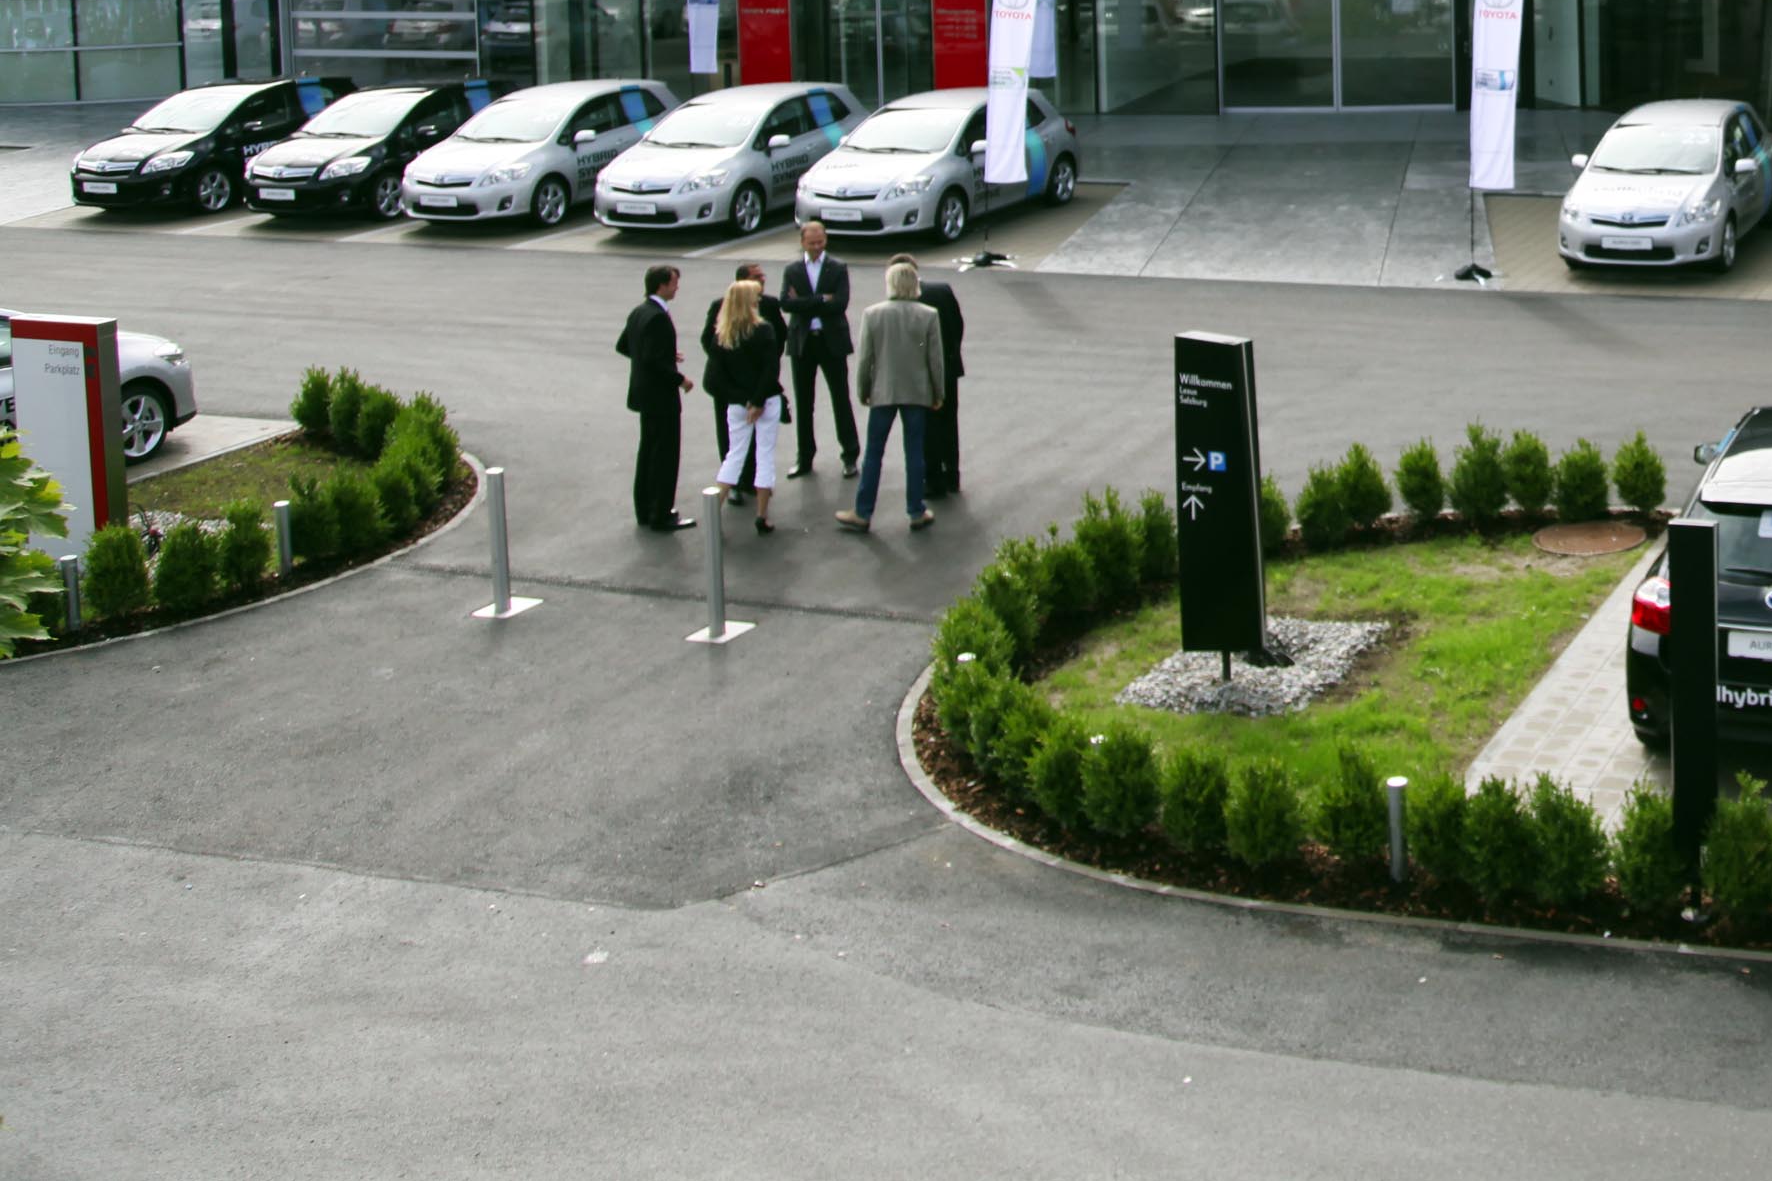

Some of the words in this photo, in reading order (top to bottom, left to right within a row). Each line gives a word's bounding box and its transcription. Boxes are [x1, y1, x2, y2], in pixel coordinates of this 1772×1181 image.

[994, 10, 1032, 20] TOYOTA
[1479, 10, 1517, 20] TOYOTA
[577, 148, 618, 166] HYBRID
[771, 153, 809, 172] HYBRID
[48, 344, 80, 358] Eingang
[44, 363, 81, 376] Parkplatz
[1179, 372, 1233, 390] Willkommen
[1210, 452, 1223, 470] P
